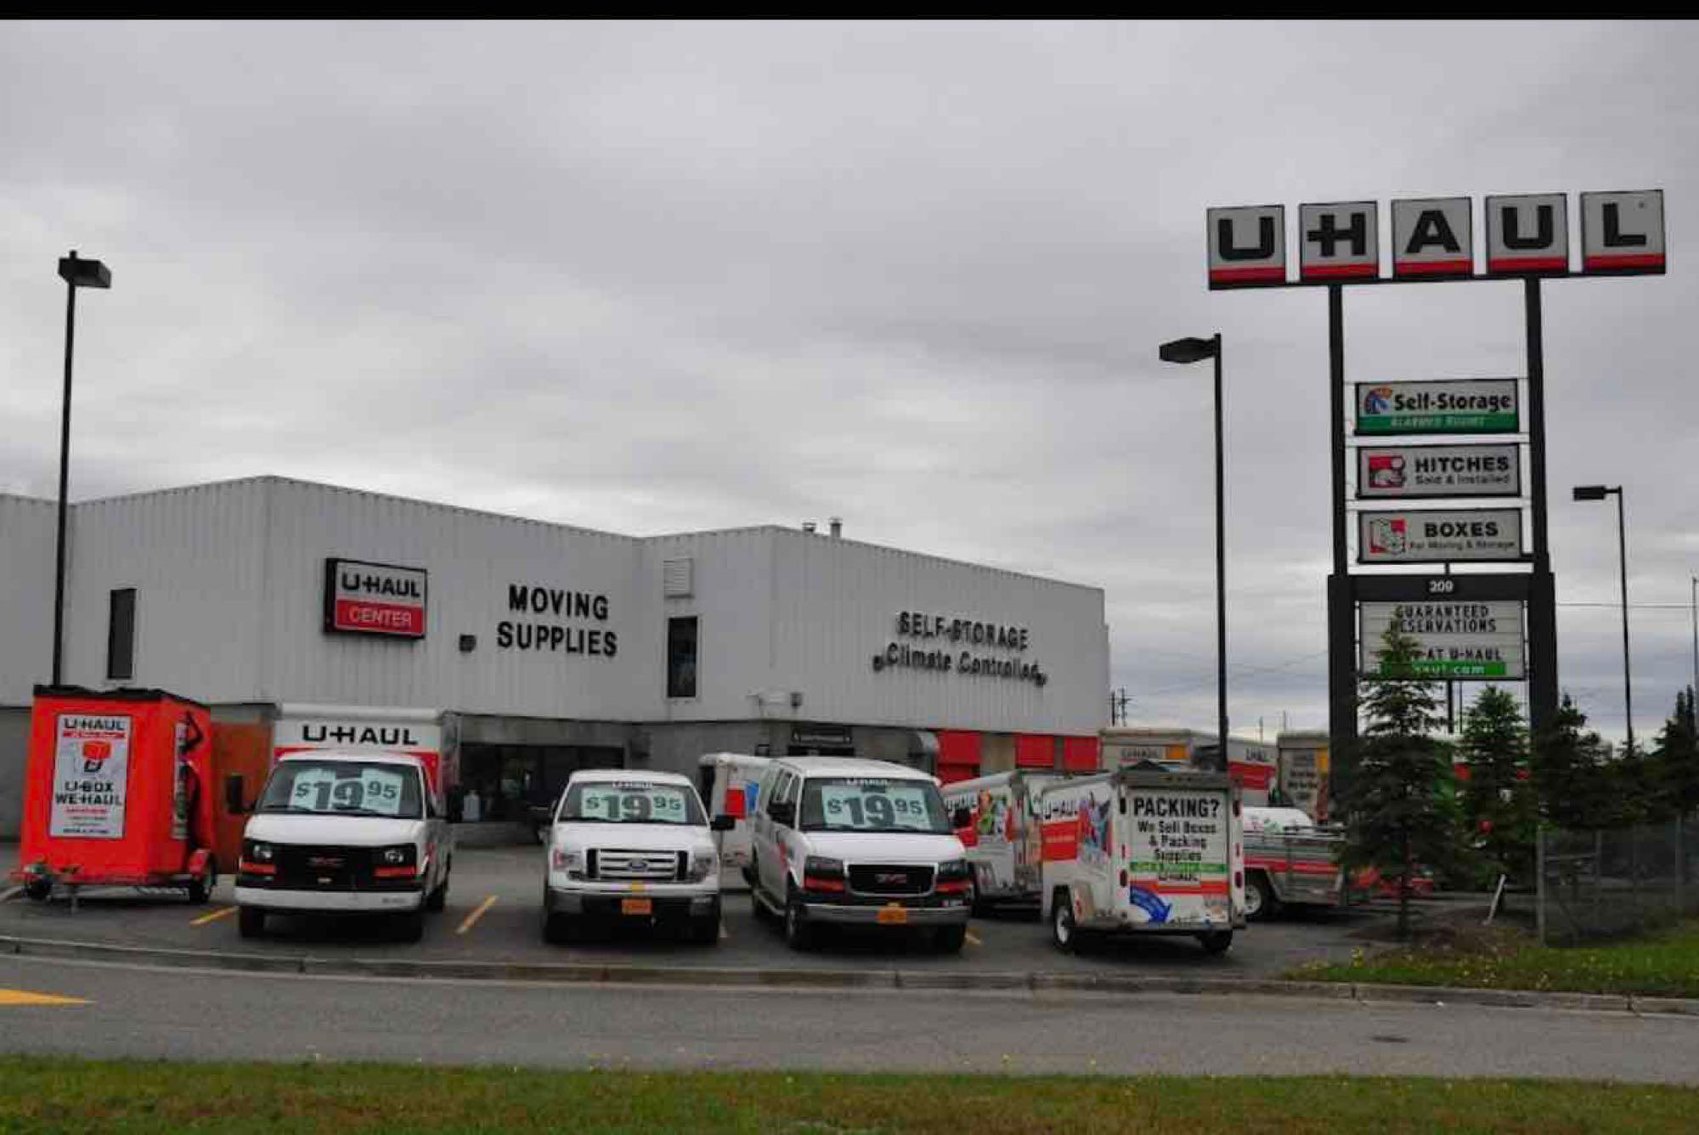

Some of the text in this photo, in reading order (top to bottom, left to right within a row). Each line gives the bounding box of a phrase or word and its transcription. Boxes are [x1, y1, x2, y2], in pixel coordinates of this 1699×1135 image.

[1394, 391, 1512, 416] Self-Storage
[1415, 456, 1509, 473] HITCHES
[1445, 475, 1454, 485] &
[1425, 522, 1498, 537] BOXES
[341, 572, 421, 598] U-HAUL
[1429, 580, 1453, 592] 209
[509, 584, 608, 620] MOVING
[348, 605, 412, 628] CENTER
[1396, 605, 1489, 618] GUARANTEED
[497, 621, 617, 657] SUPPLIES
[897, 610, 1029, 650] SELF-STORAGE
[886, 641, 1040, 681] Climate Controlled
[1450, 647, 1504, 660] U-HAUL
[302, 725, 418, 745] U-HAUL
[1133, 798, 1219, 818] PACKING?
[1138, 821, 1217, 833] We Sell Boxes
[1161, 834, 1207, 849] Packing
[1153, 849, 1202, 864] Supplies
